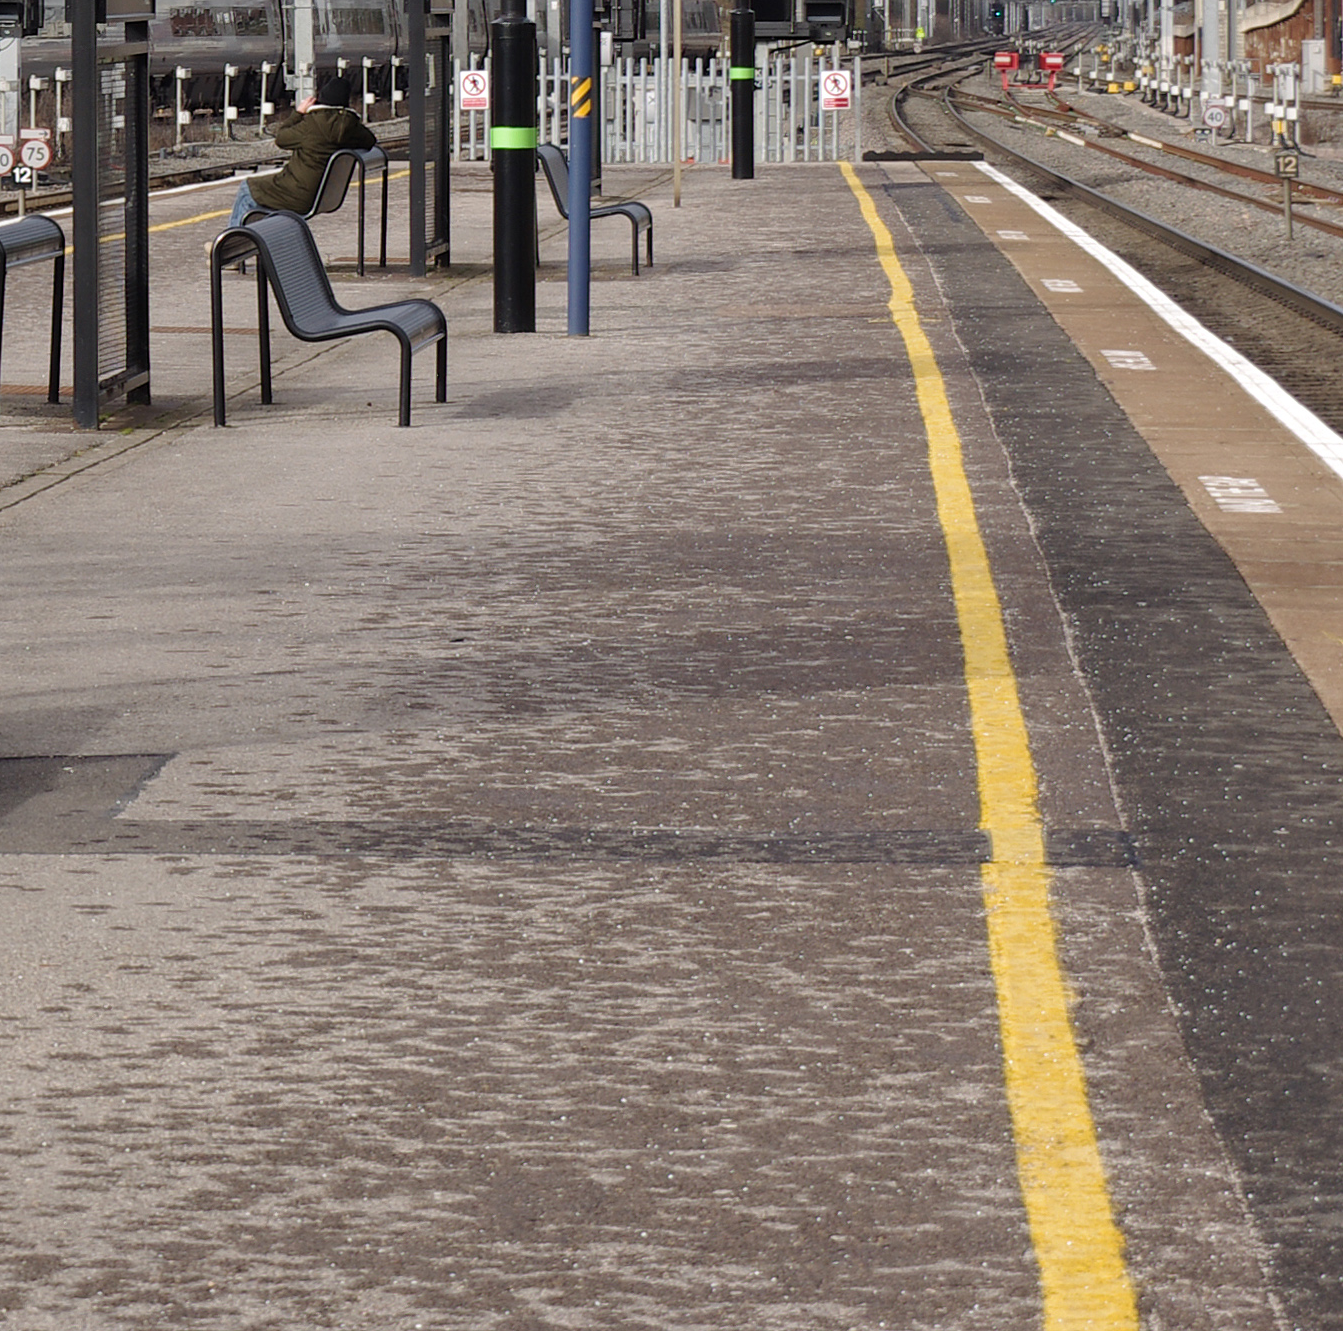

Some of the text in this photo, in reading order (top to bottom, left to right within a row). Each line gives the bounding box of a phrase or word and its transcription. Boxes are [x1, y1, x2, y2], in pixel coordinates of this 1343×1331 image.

[1207, 111, 1223, 123] 40
[27, 147, 45, 162] 75
[1277, 156, 1297, 172] 12
[13, 167, 31, 183] 12
